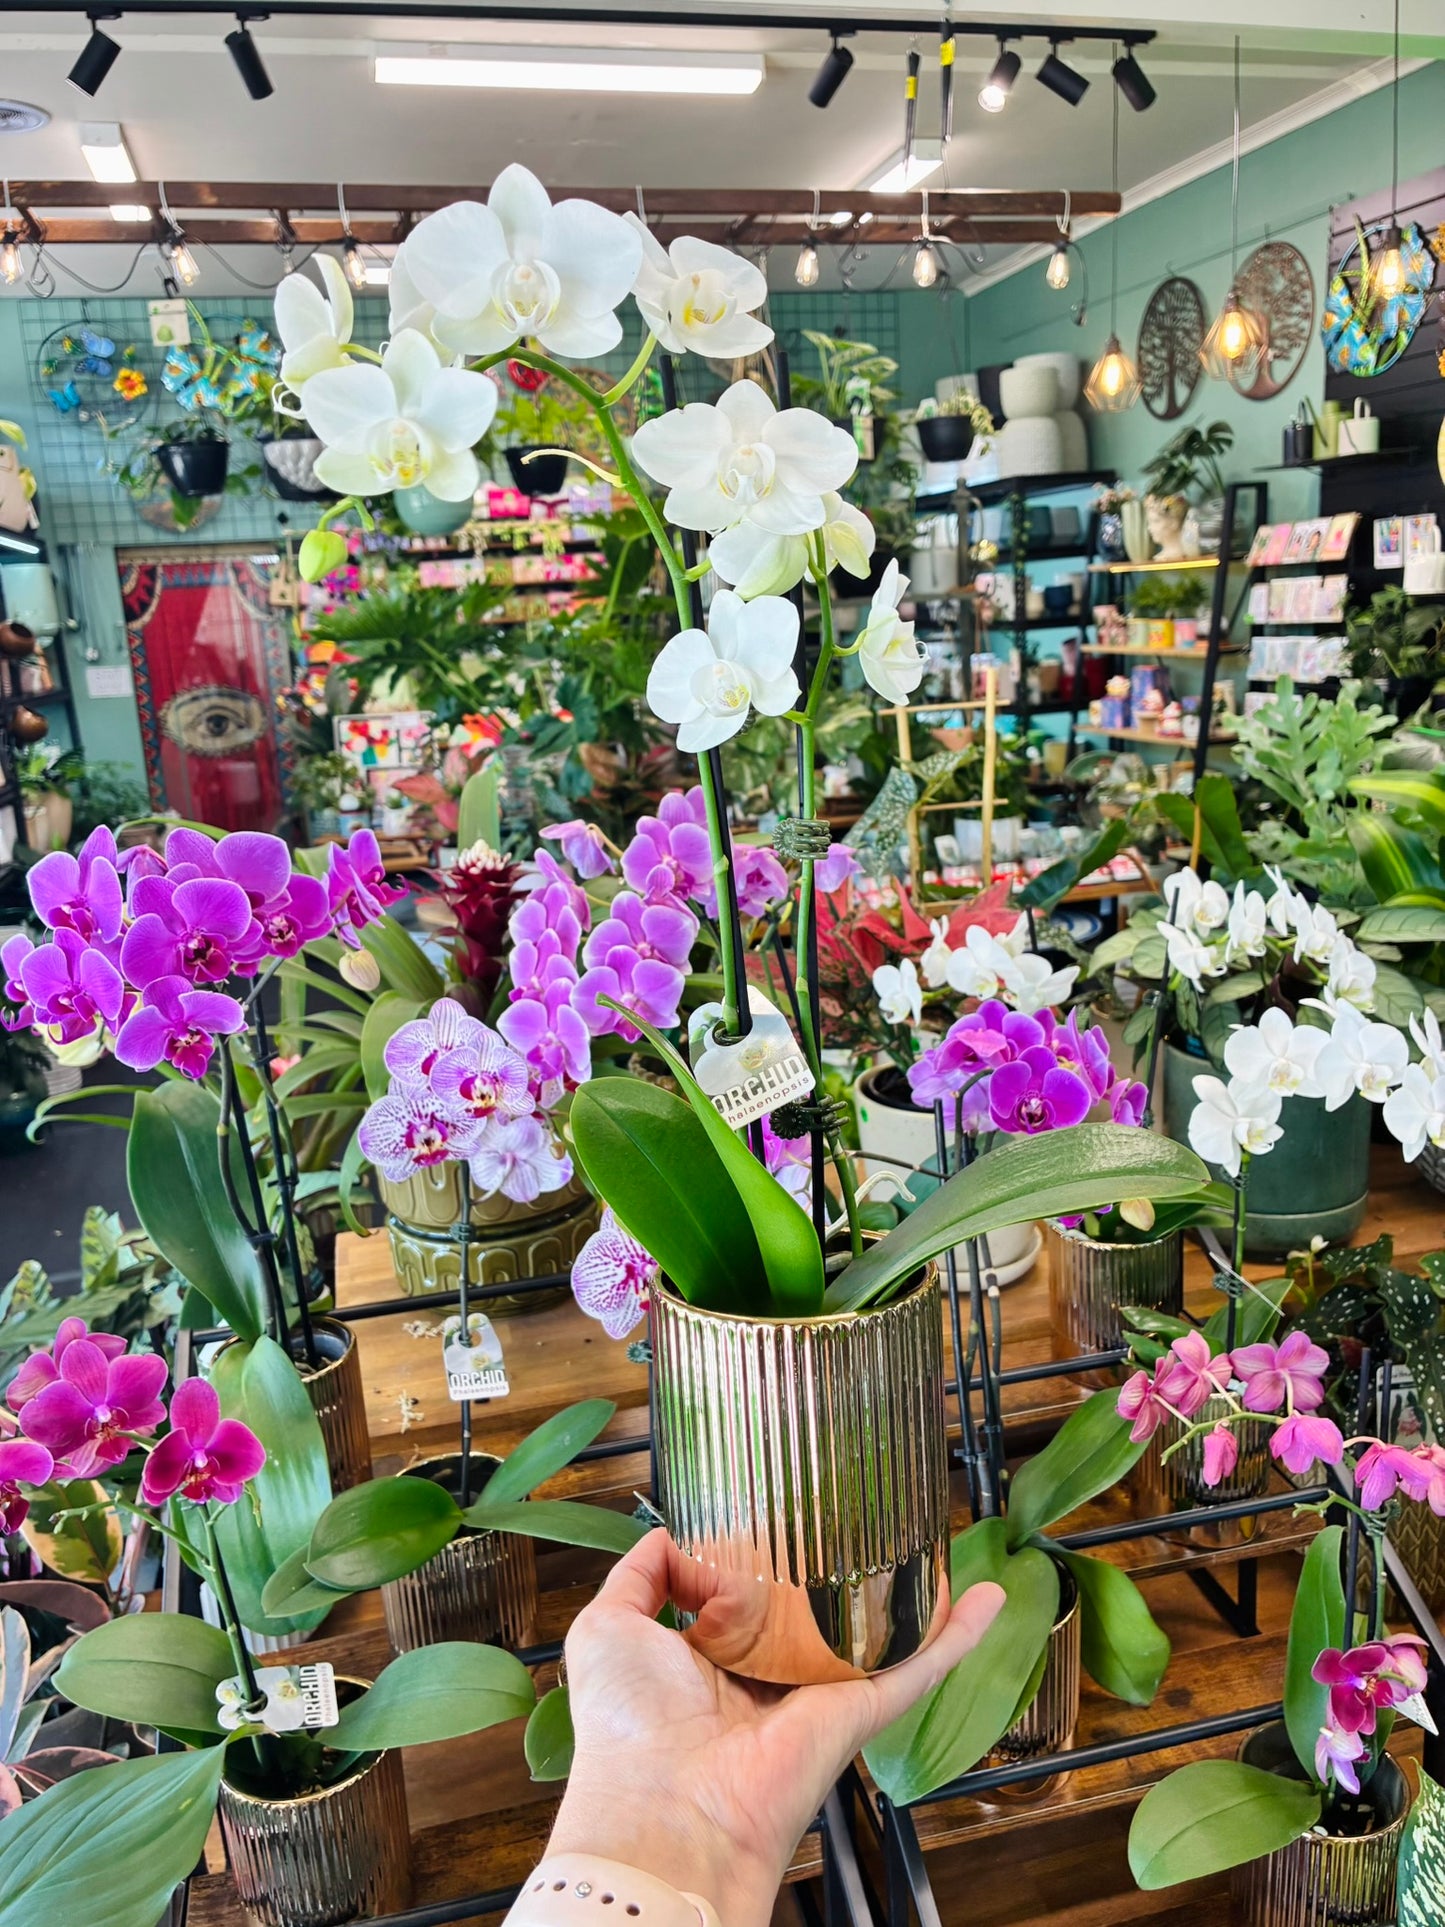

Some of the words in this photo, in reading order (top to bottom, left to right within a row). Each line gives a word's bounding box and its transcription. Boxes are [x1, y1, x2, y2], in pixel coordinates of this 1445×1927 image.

[711, 1055, 806, 1114] ORCHID
[727, 1077, 809, 1124] halaenopsis
[450, 1370, 505, 1388] ORCHID
[300, 1666, 322, 1725] ORCHID
